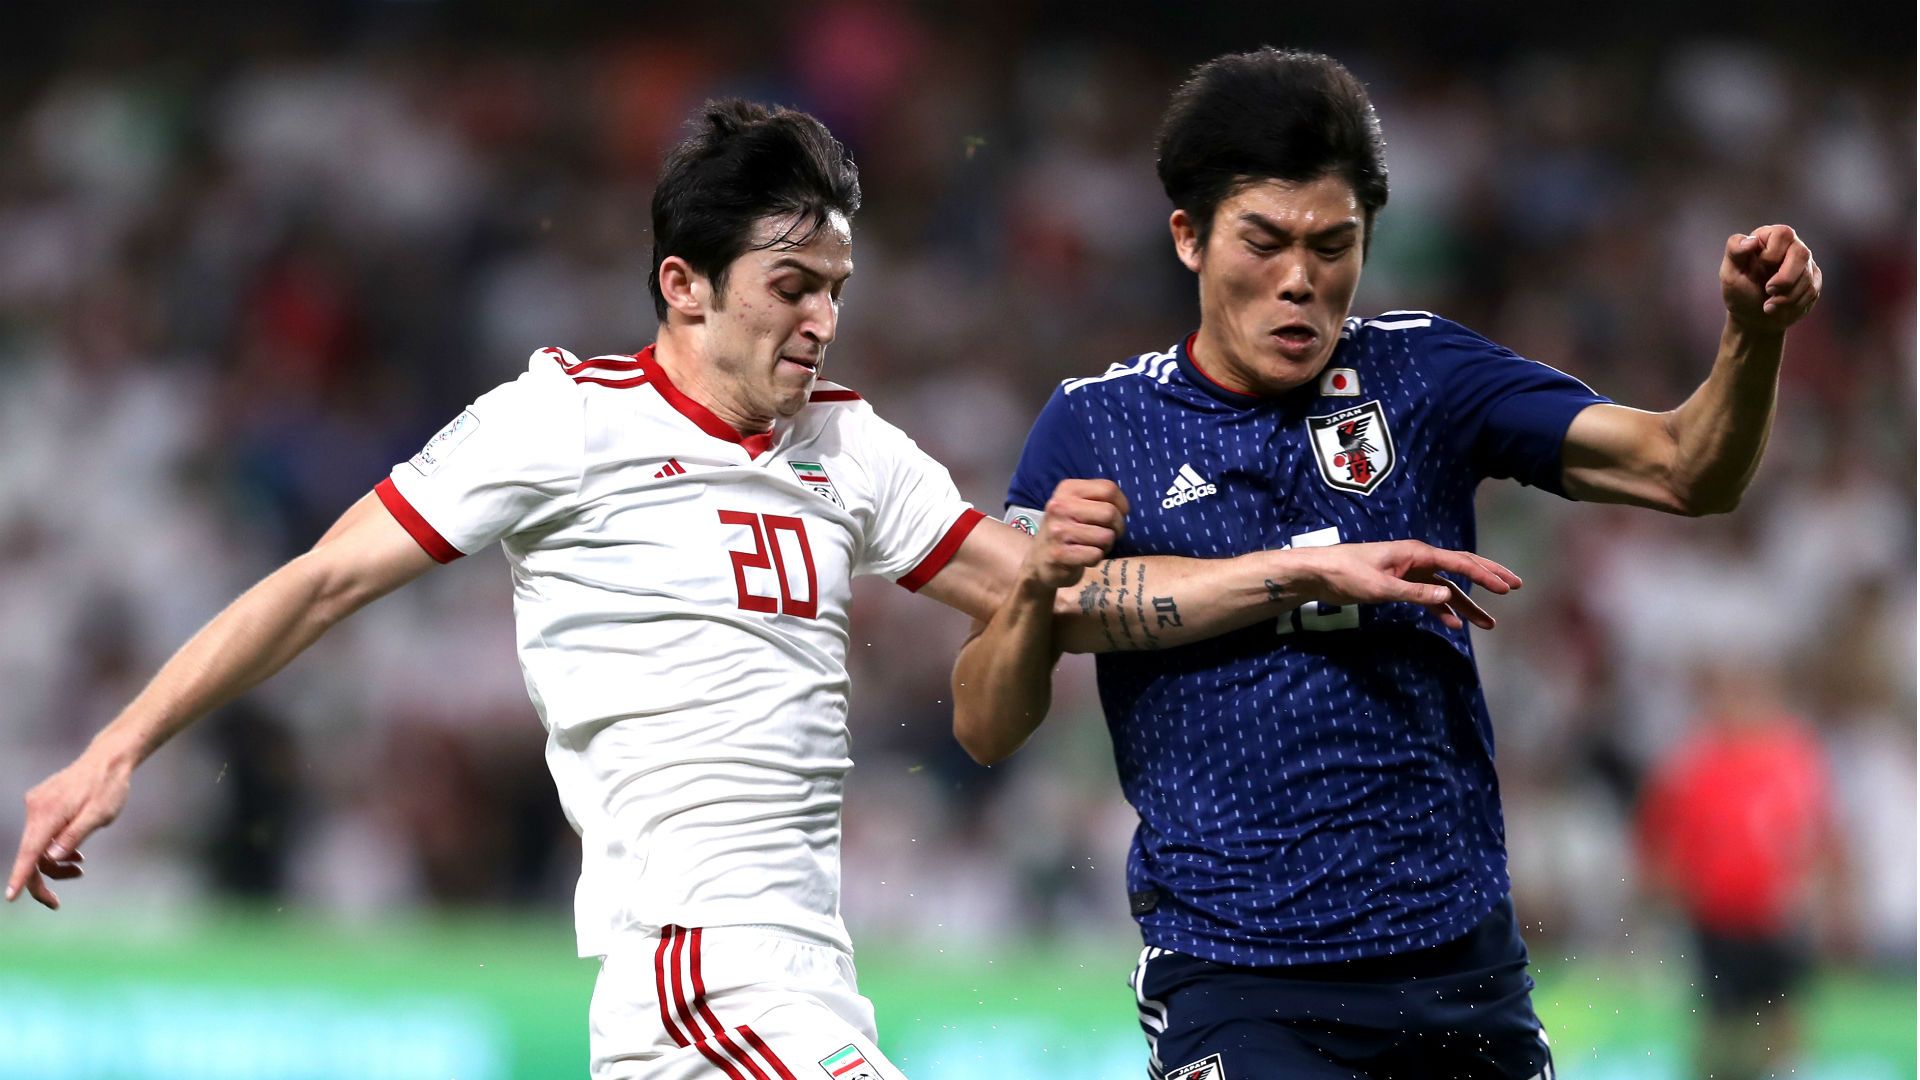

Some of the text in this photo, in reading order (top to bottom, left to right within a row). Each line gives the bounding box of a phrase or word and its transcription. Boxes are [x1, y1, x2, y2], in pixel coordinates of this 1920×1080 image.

[1325, 408, 1363, 425] JAPAN
[1346, 459, 1378, 481] JFA
[1162, 483, 1217, 509] adidas
[717, 509, 818, 620] 20
[1152, 596, 1184, 629] 20
[1179, 1060, 1207, 1075] JAPAN
